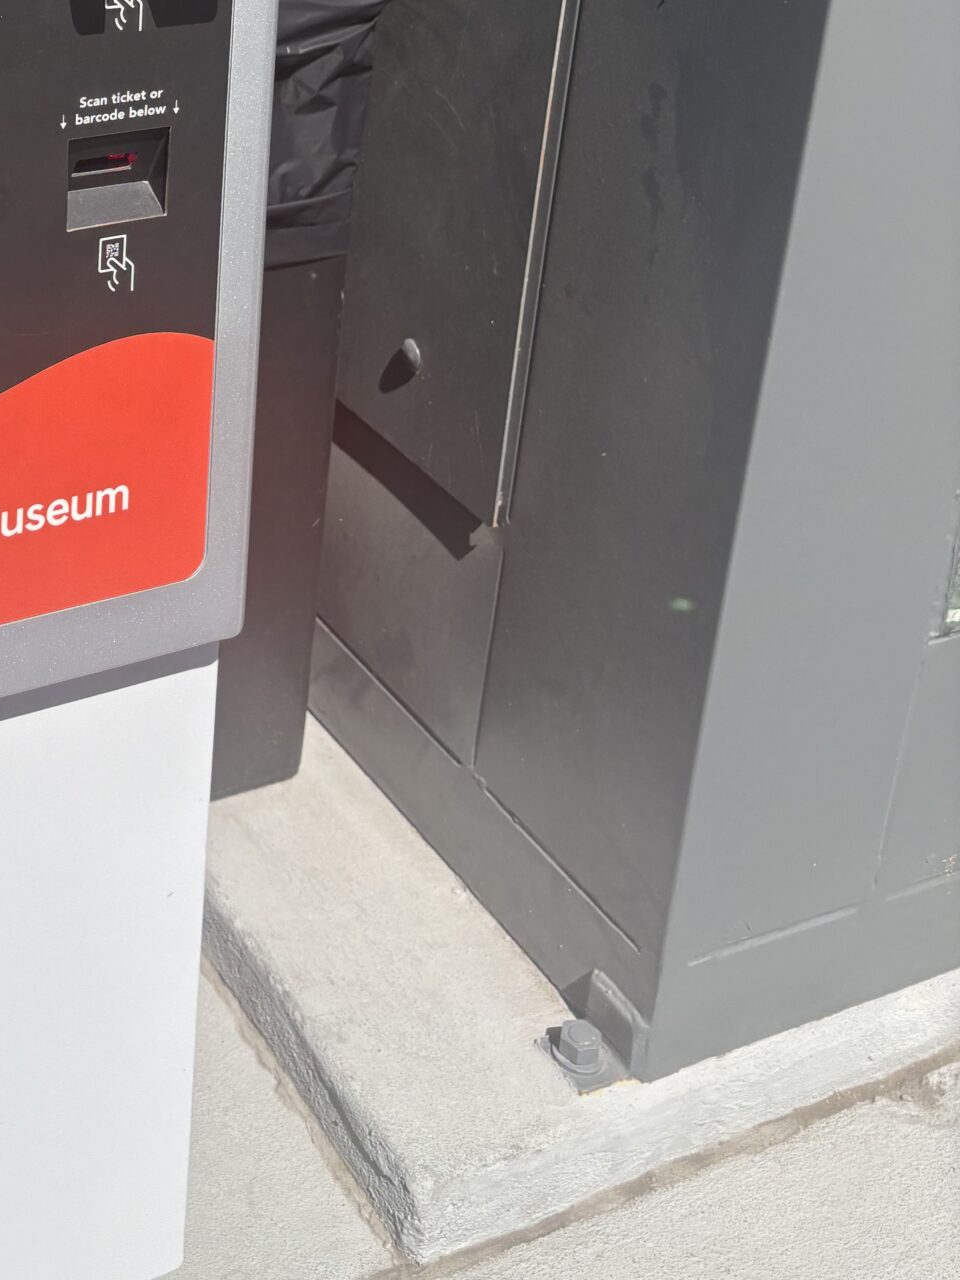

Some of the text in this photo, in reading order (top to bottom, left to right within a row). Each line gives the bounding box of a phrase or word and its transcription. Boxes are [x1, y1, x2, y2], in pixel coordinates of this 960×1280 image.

[79, 89, 164, 109] Scan ticket or
[75, 104, 167, 126] barcode below
